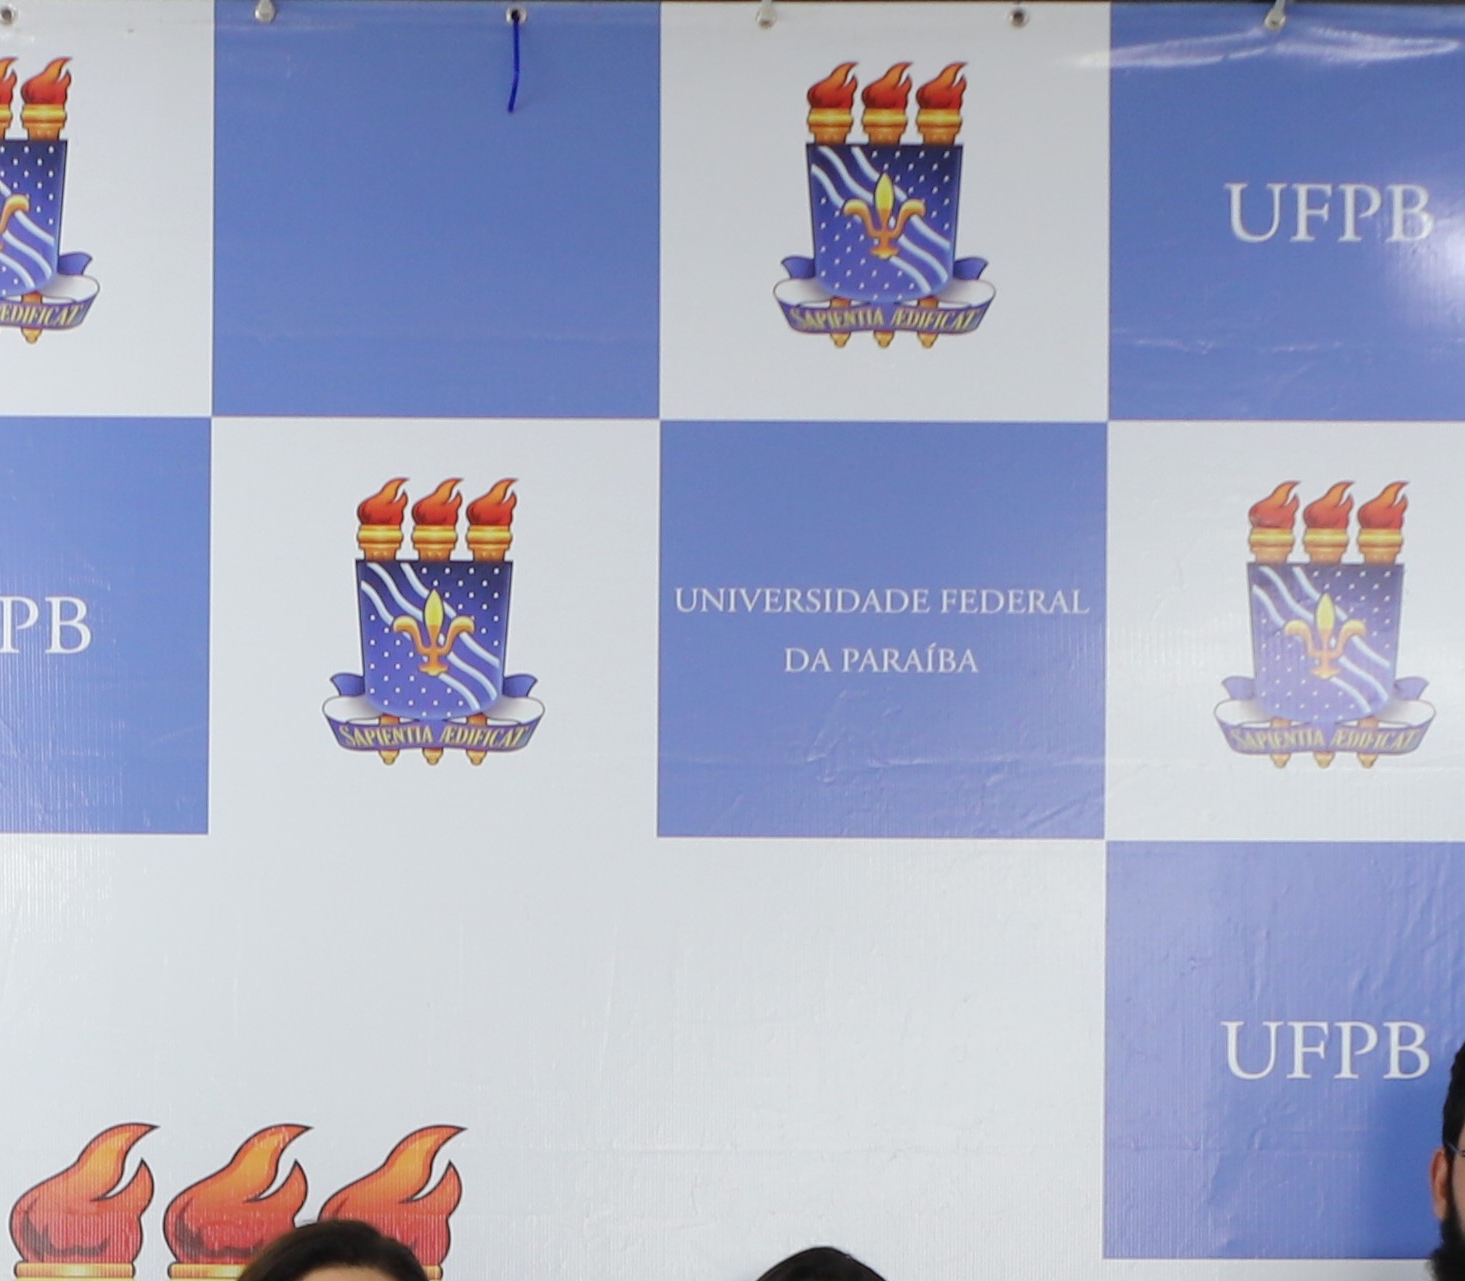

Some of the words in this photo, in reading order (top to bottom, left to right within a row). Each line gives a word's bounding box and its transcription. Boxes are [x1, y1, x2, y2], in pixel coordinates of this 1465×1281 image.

[1226, 182, 1433, 243] UFPB
[791, 308, 885, 331] SAPIENTIA
[890, 308, 978, 331] ÆDIFICAT
[674, 587, 930, 615] UNIVERSIDADE
[940, 587, 1089, 615] FEDERAL
[784, 646, 831, 673] DA
[842, 640, 979, 673] PARAÍBA
[339, 725, 433, 748] SAPIENTIA
[438, 725, 526, 748] ÆDIFICAT
[1223, 1020, 1430, 1081] UFPB
